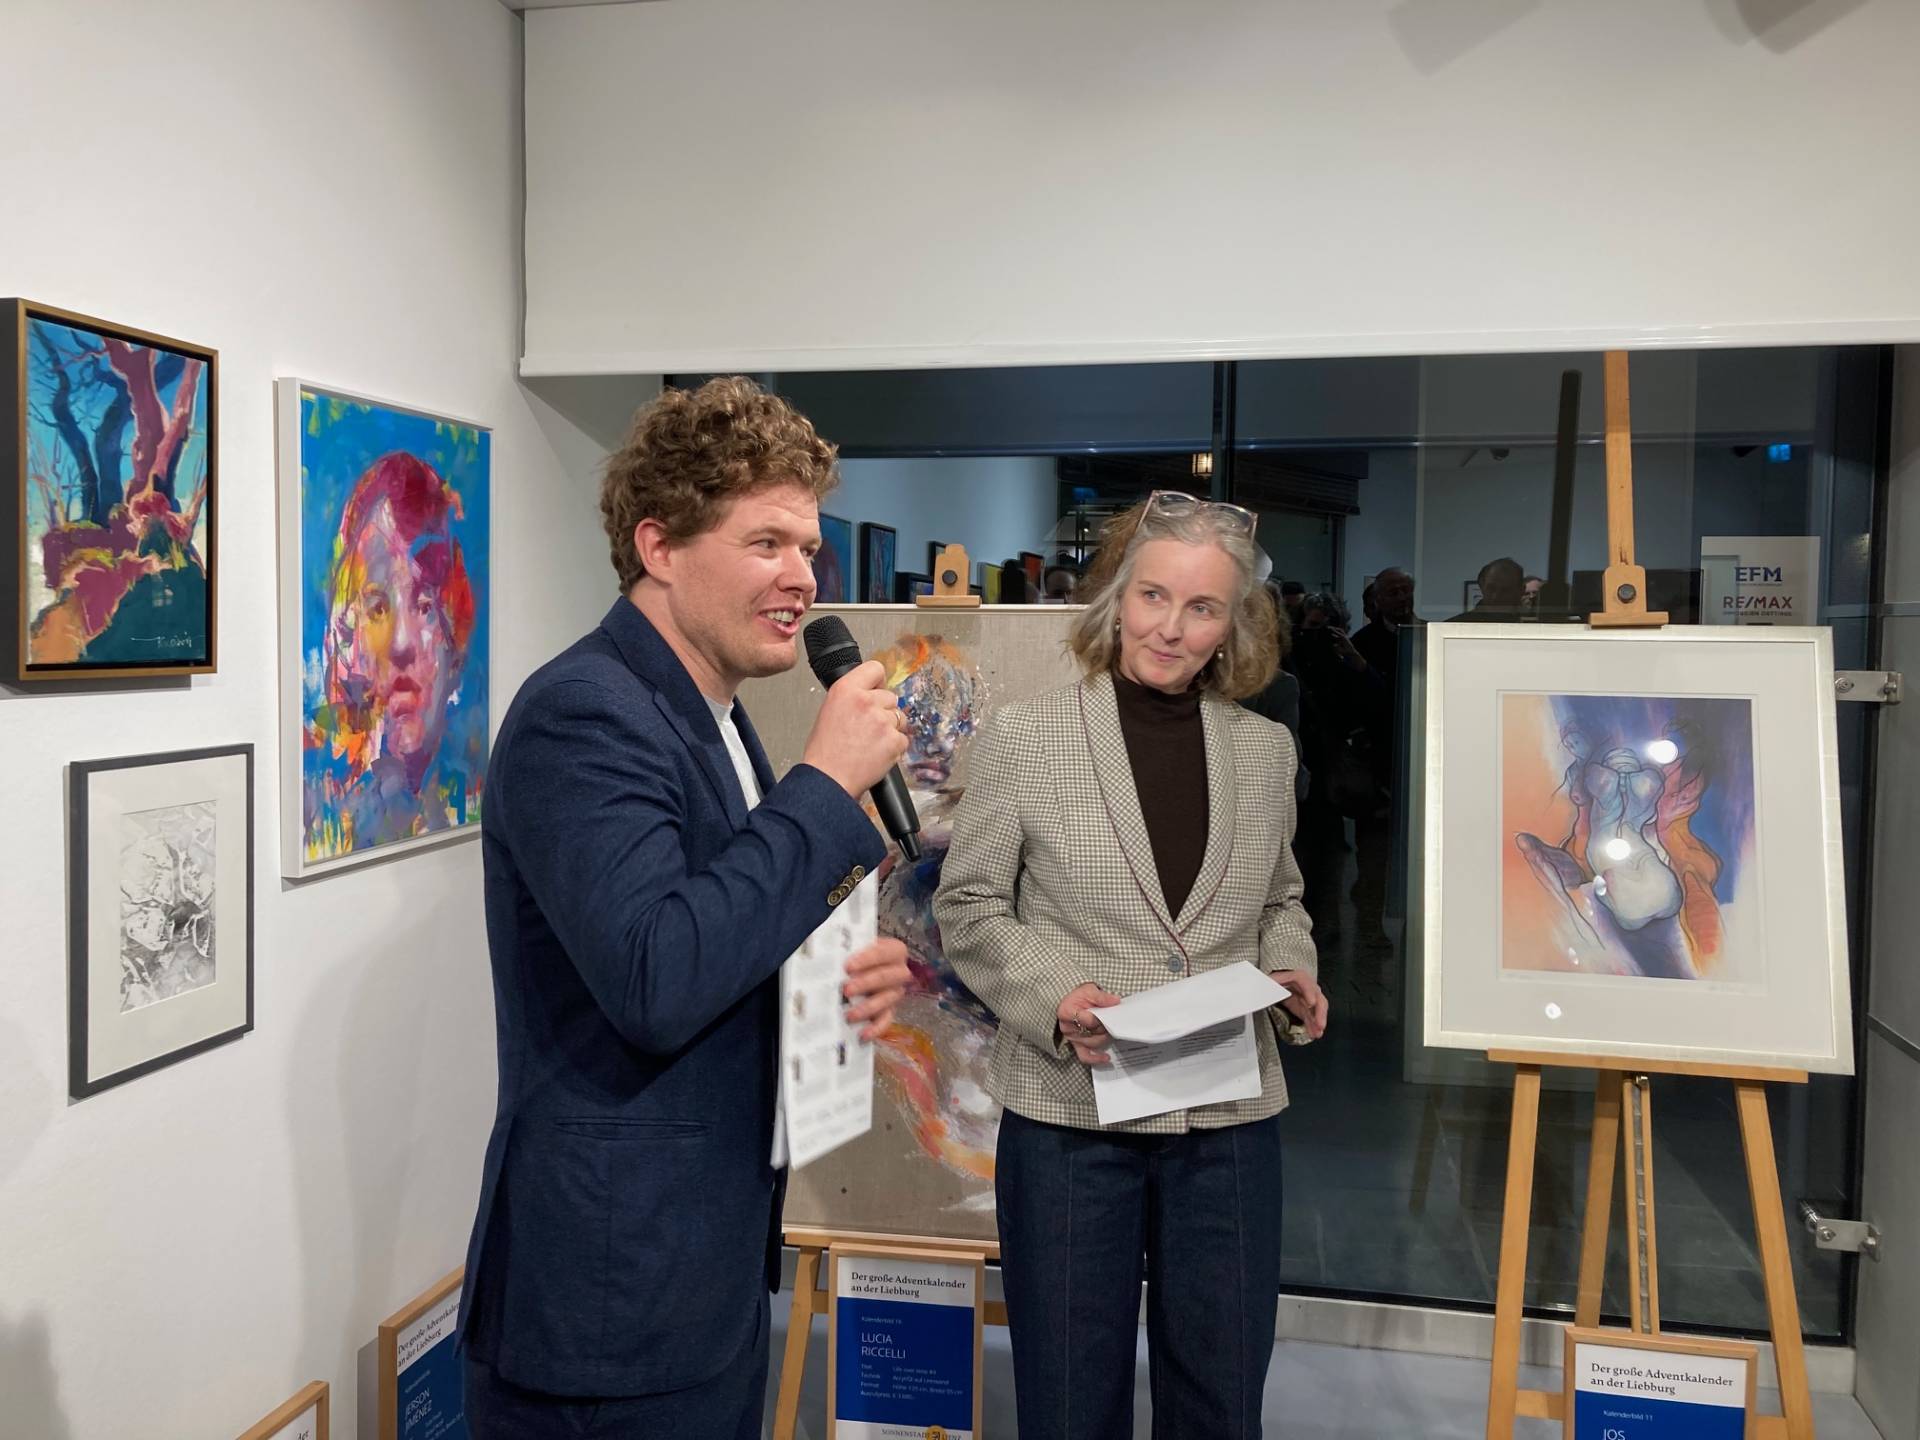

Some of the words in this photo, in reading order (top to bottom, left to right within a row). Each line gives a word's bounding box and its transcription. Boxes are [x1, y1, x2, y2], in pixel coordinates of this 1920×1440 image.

[1734, 566, 1783, 582] EFM
[1722, 595, 1793, 609] RE/MAX
[851, 1271, 867, 1281] Der
[869, 1274, 893, 1283] große
[895, 1275, 966, 1289] Adventkalender
[851, 1284, 862, 1292] an
[864, 1285, 878, 1293] der
[880, 1285, 920, 1298] Liebburg
[861, 1331, 893, 1345] LUCIA
[861, 1346, 906, 1359] RICCELLI
[1591, 1362, 1611, 1373] Der
[1613, 1366, 1643, 1377] große
[1645, 1368, 1734, 1386] Adventkalender
[1590, 1377, 1604, 1386] an
[1606, 1377, 1624, 1388] der
[1626, 1379, 1676, 1395] Liebburg
[1603, 1428, 1626, 1440] JOS
